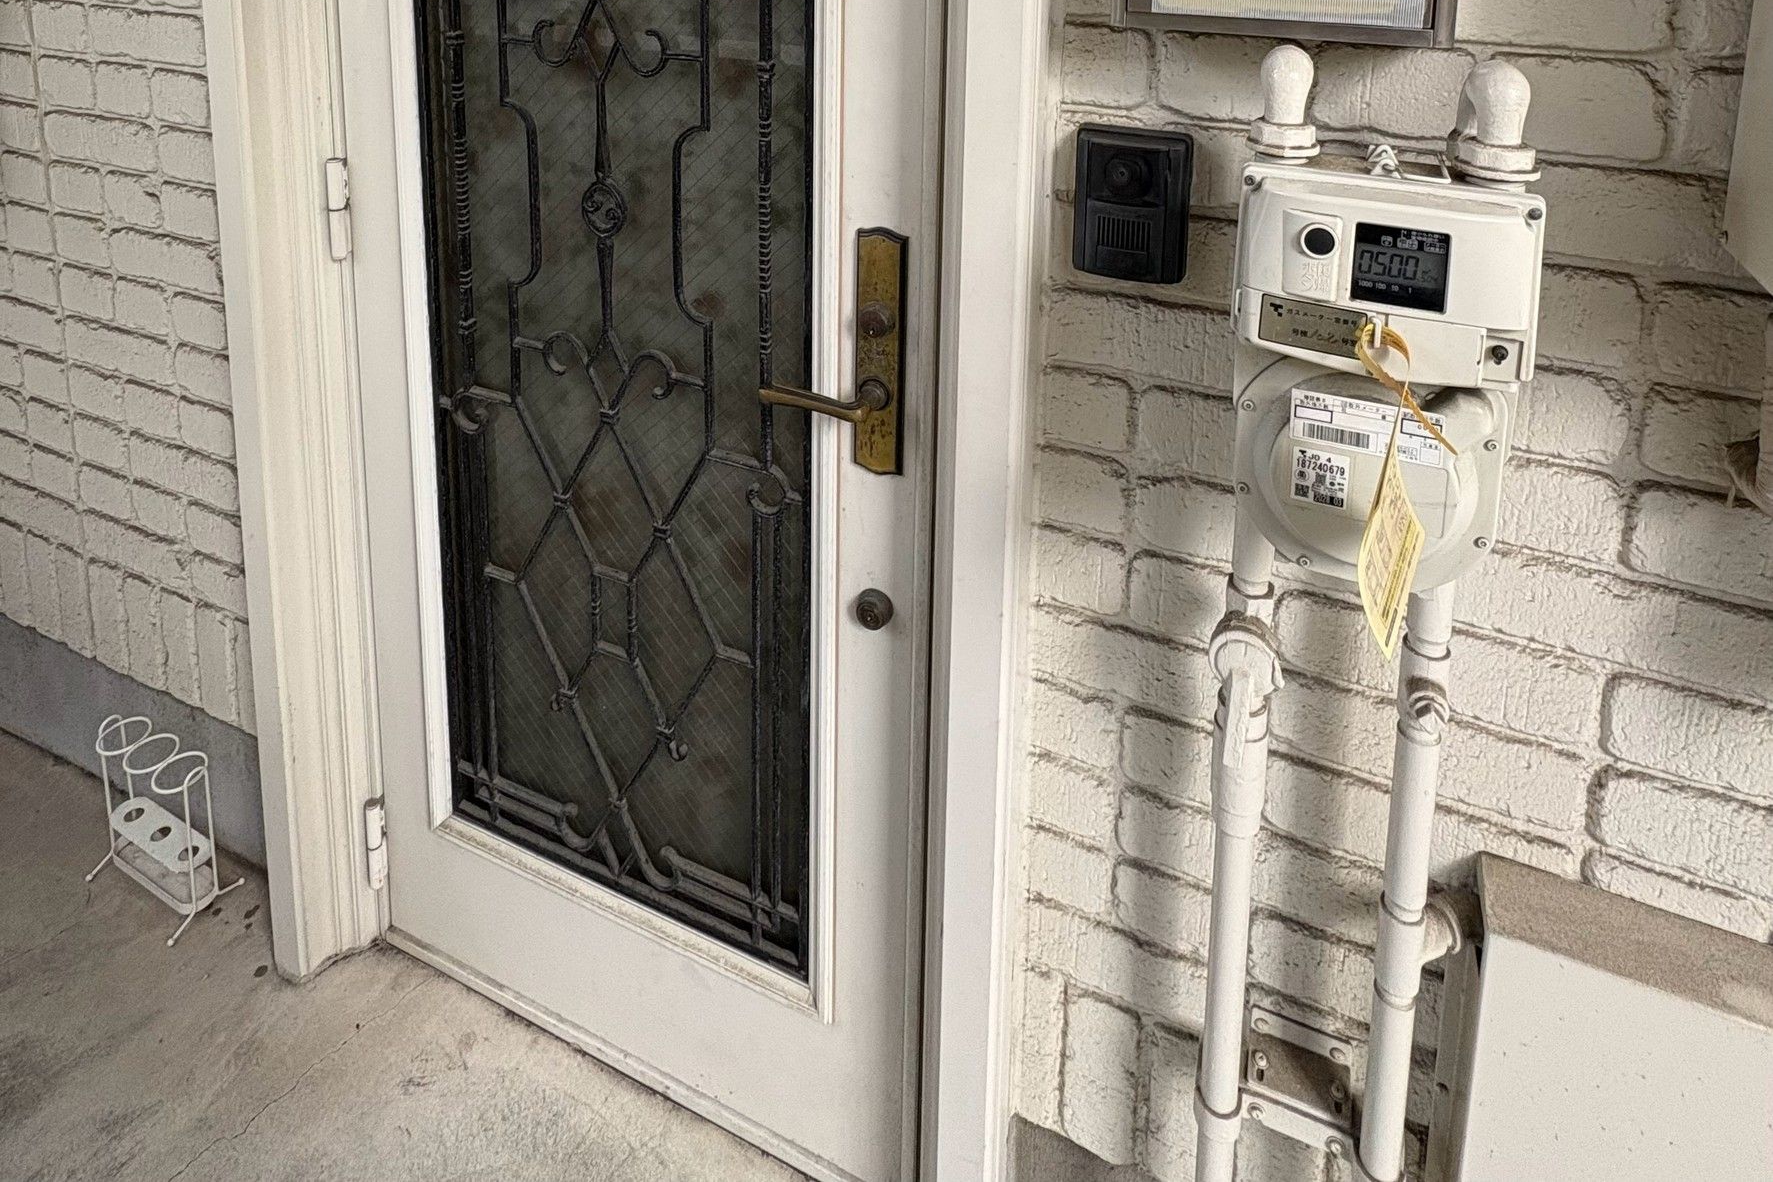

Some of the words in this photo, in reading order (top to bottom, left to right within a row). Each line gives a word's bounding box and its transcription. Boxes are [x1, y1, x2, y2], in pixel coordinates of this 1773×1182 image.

[1358, 249, 1420, 280] 0500
[1358, 279, 1373, 288] 1000
[1375, 282, 1387, 290] 100
[1296, 457, 1345, 476] 187240679
